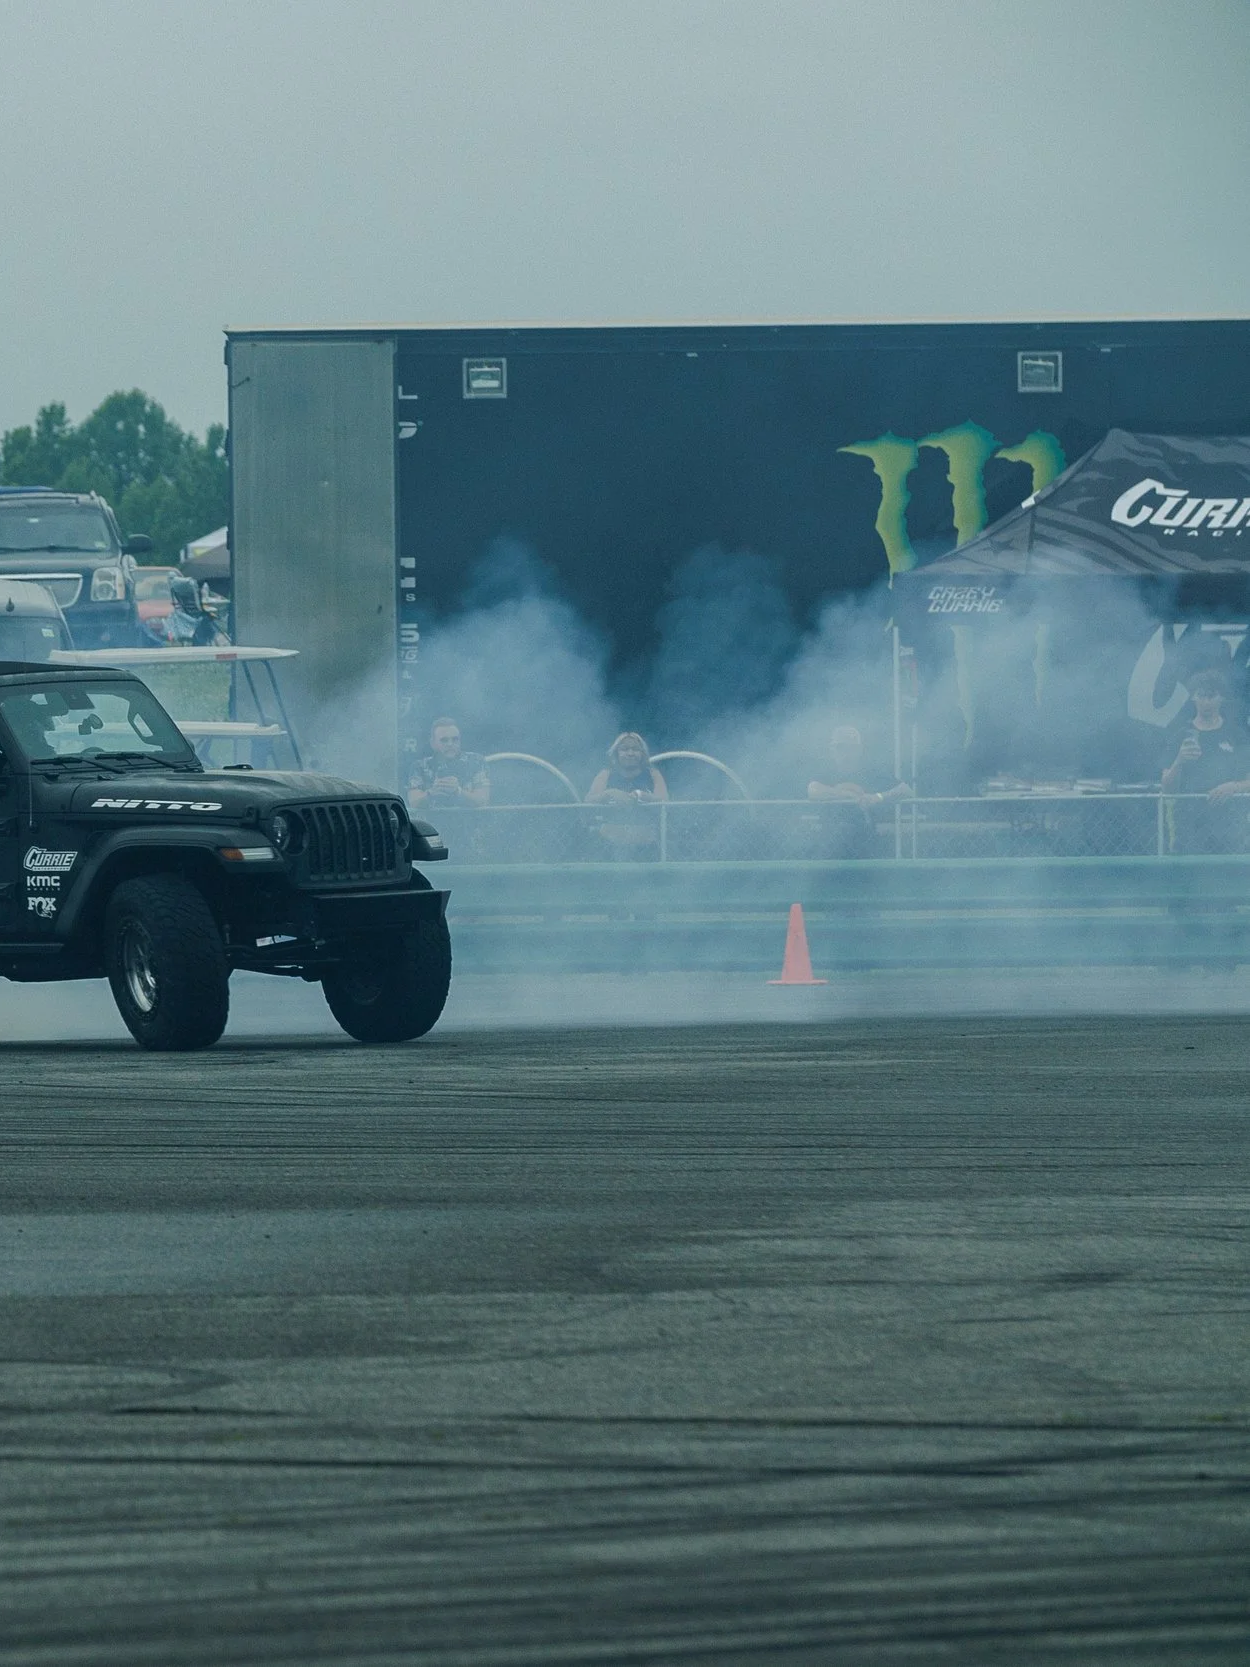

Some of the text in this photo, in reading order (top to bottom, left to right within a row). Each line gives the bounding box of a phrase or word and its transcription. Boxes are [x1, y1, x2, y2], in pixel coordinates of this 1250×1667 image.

[91, 798, 223, 811] NITTO
[25, 848, 75, 868] CURRIE
[26, 875, 61, 887] KMC
[27, 896, 57, 918] FOX
